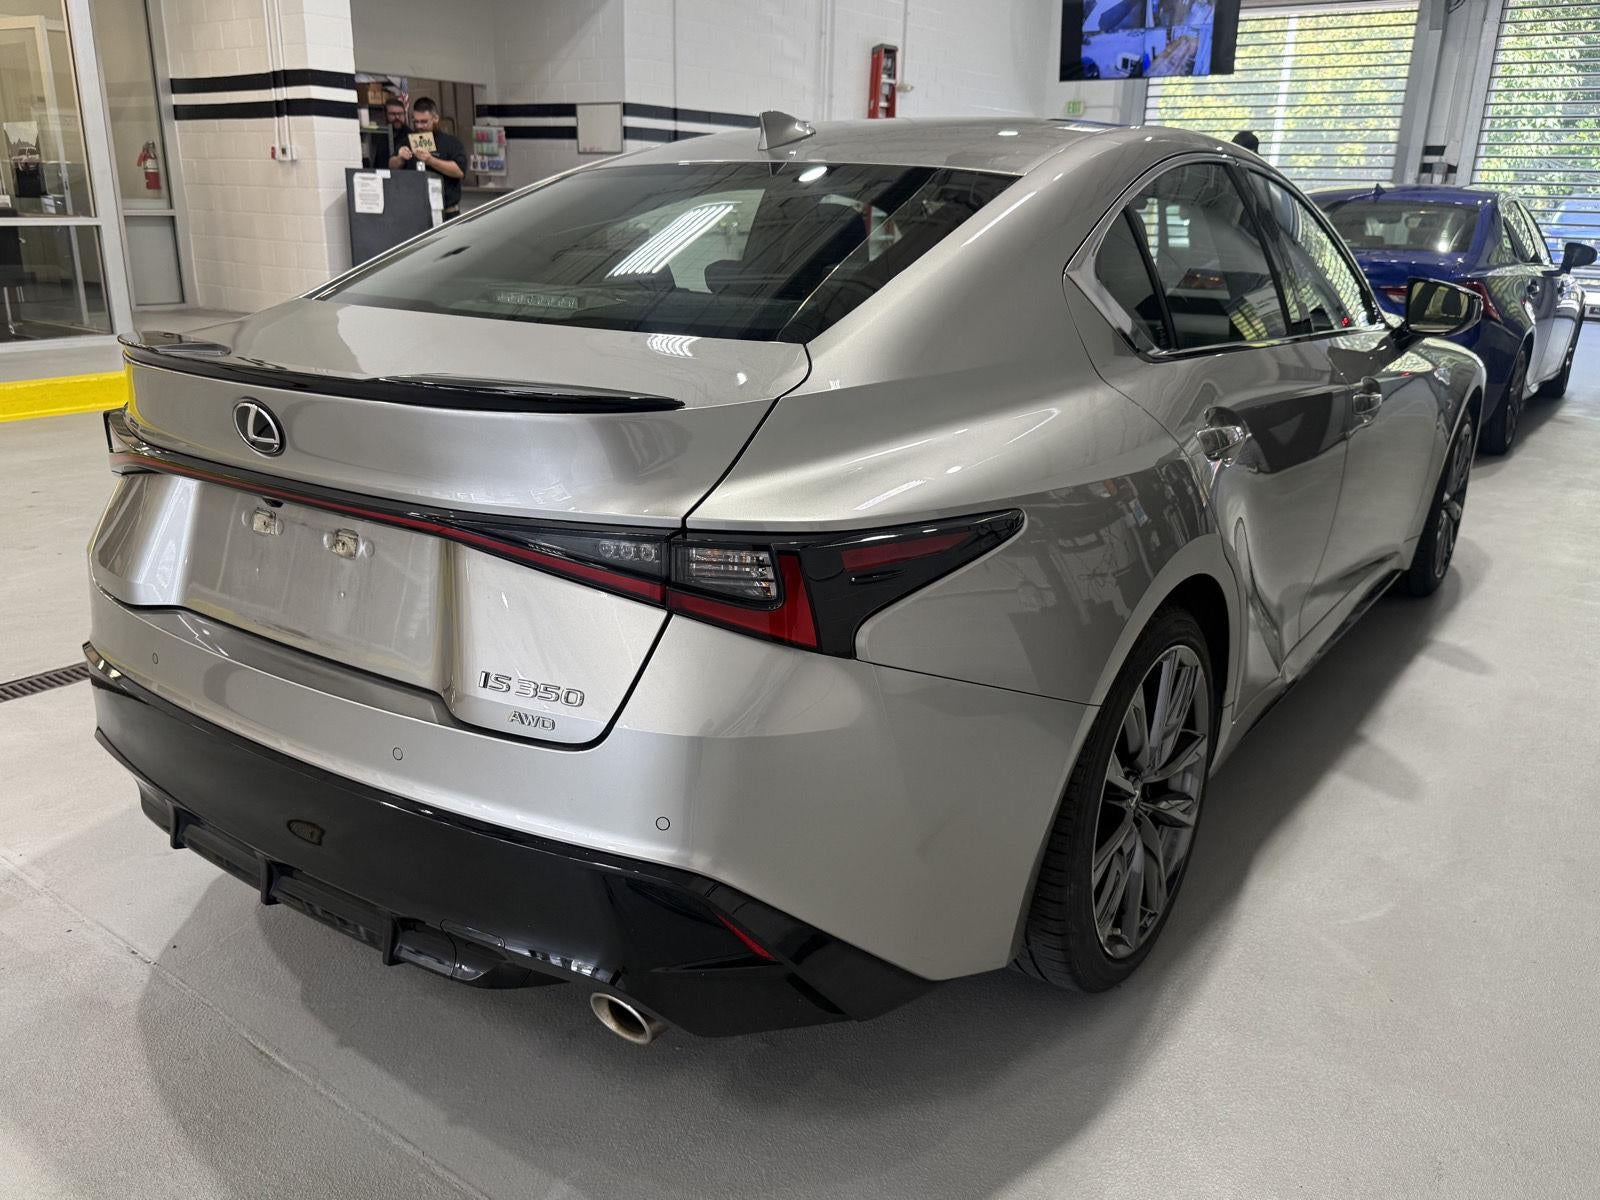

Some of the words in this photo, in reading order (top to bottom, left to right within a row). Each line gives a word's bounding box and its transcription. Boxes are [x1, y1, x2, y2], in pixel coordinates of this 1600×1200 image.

[478, 671, 512, 693] IS
[515, 678, 585, 707] 350
[509, 710, 556, 731] AWD
